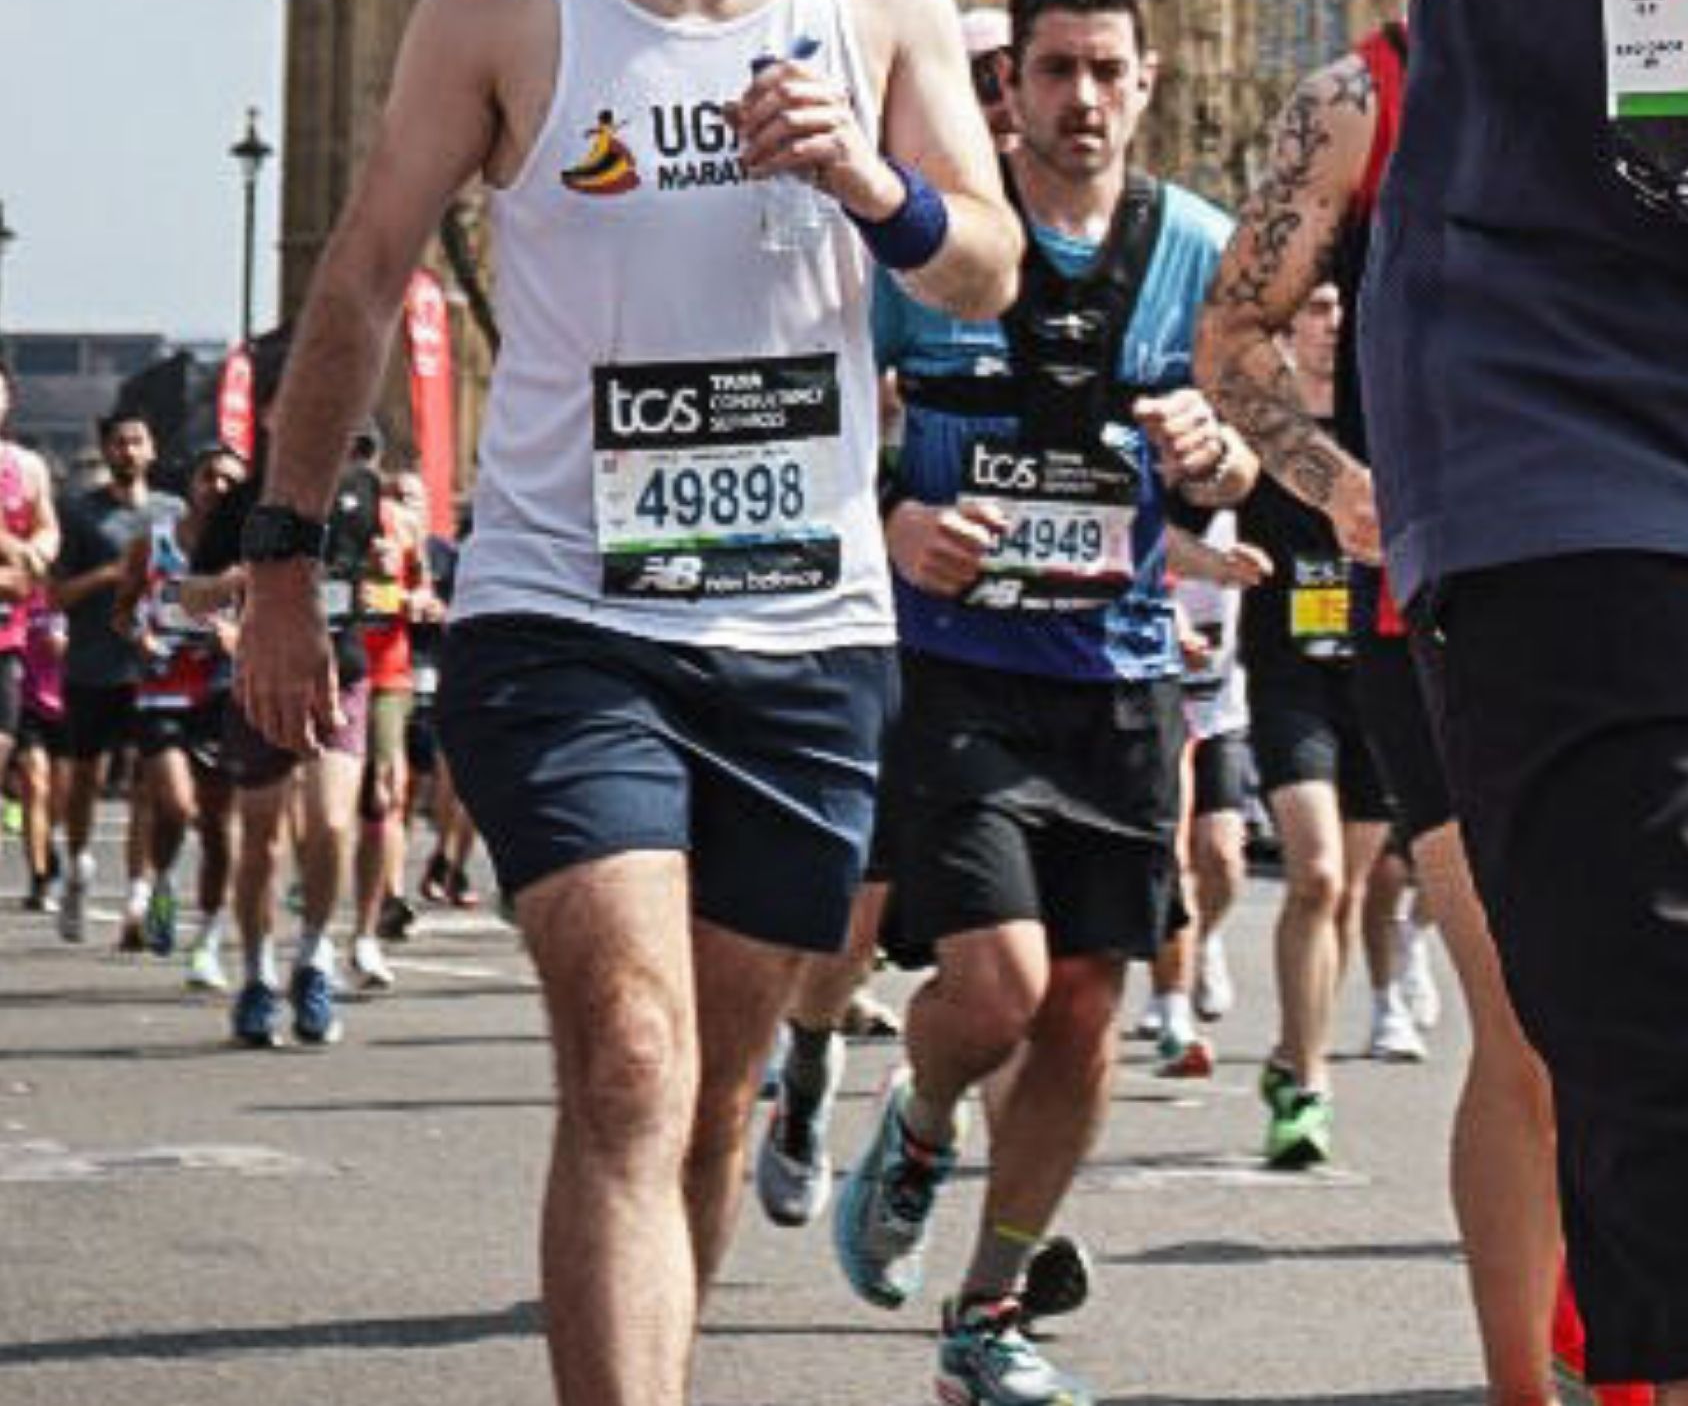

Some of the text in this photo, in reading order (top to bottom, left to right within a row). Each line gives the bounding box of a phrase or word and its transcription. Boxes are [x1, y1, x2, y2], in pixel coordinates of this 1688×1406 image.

[650, 101, 738, 157] UG
[608, 378, 700, 435] tcs
[974, 443, 1037, 489] tcs
[634, 463, 805, 527] 49898
